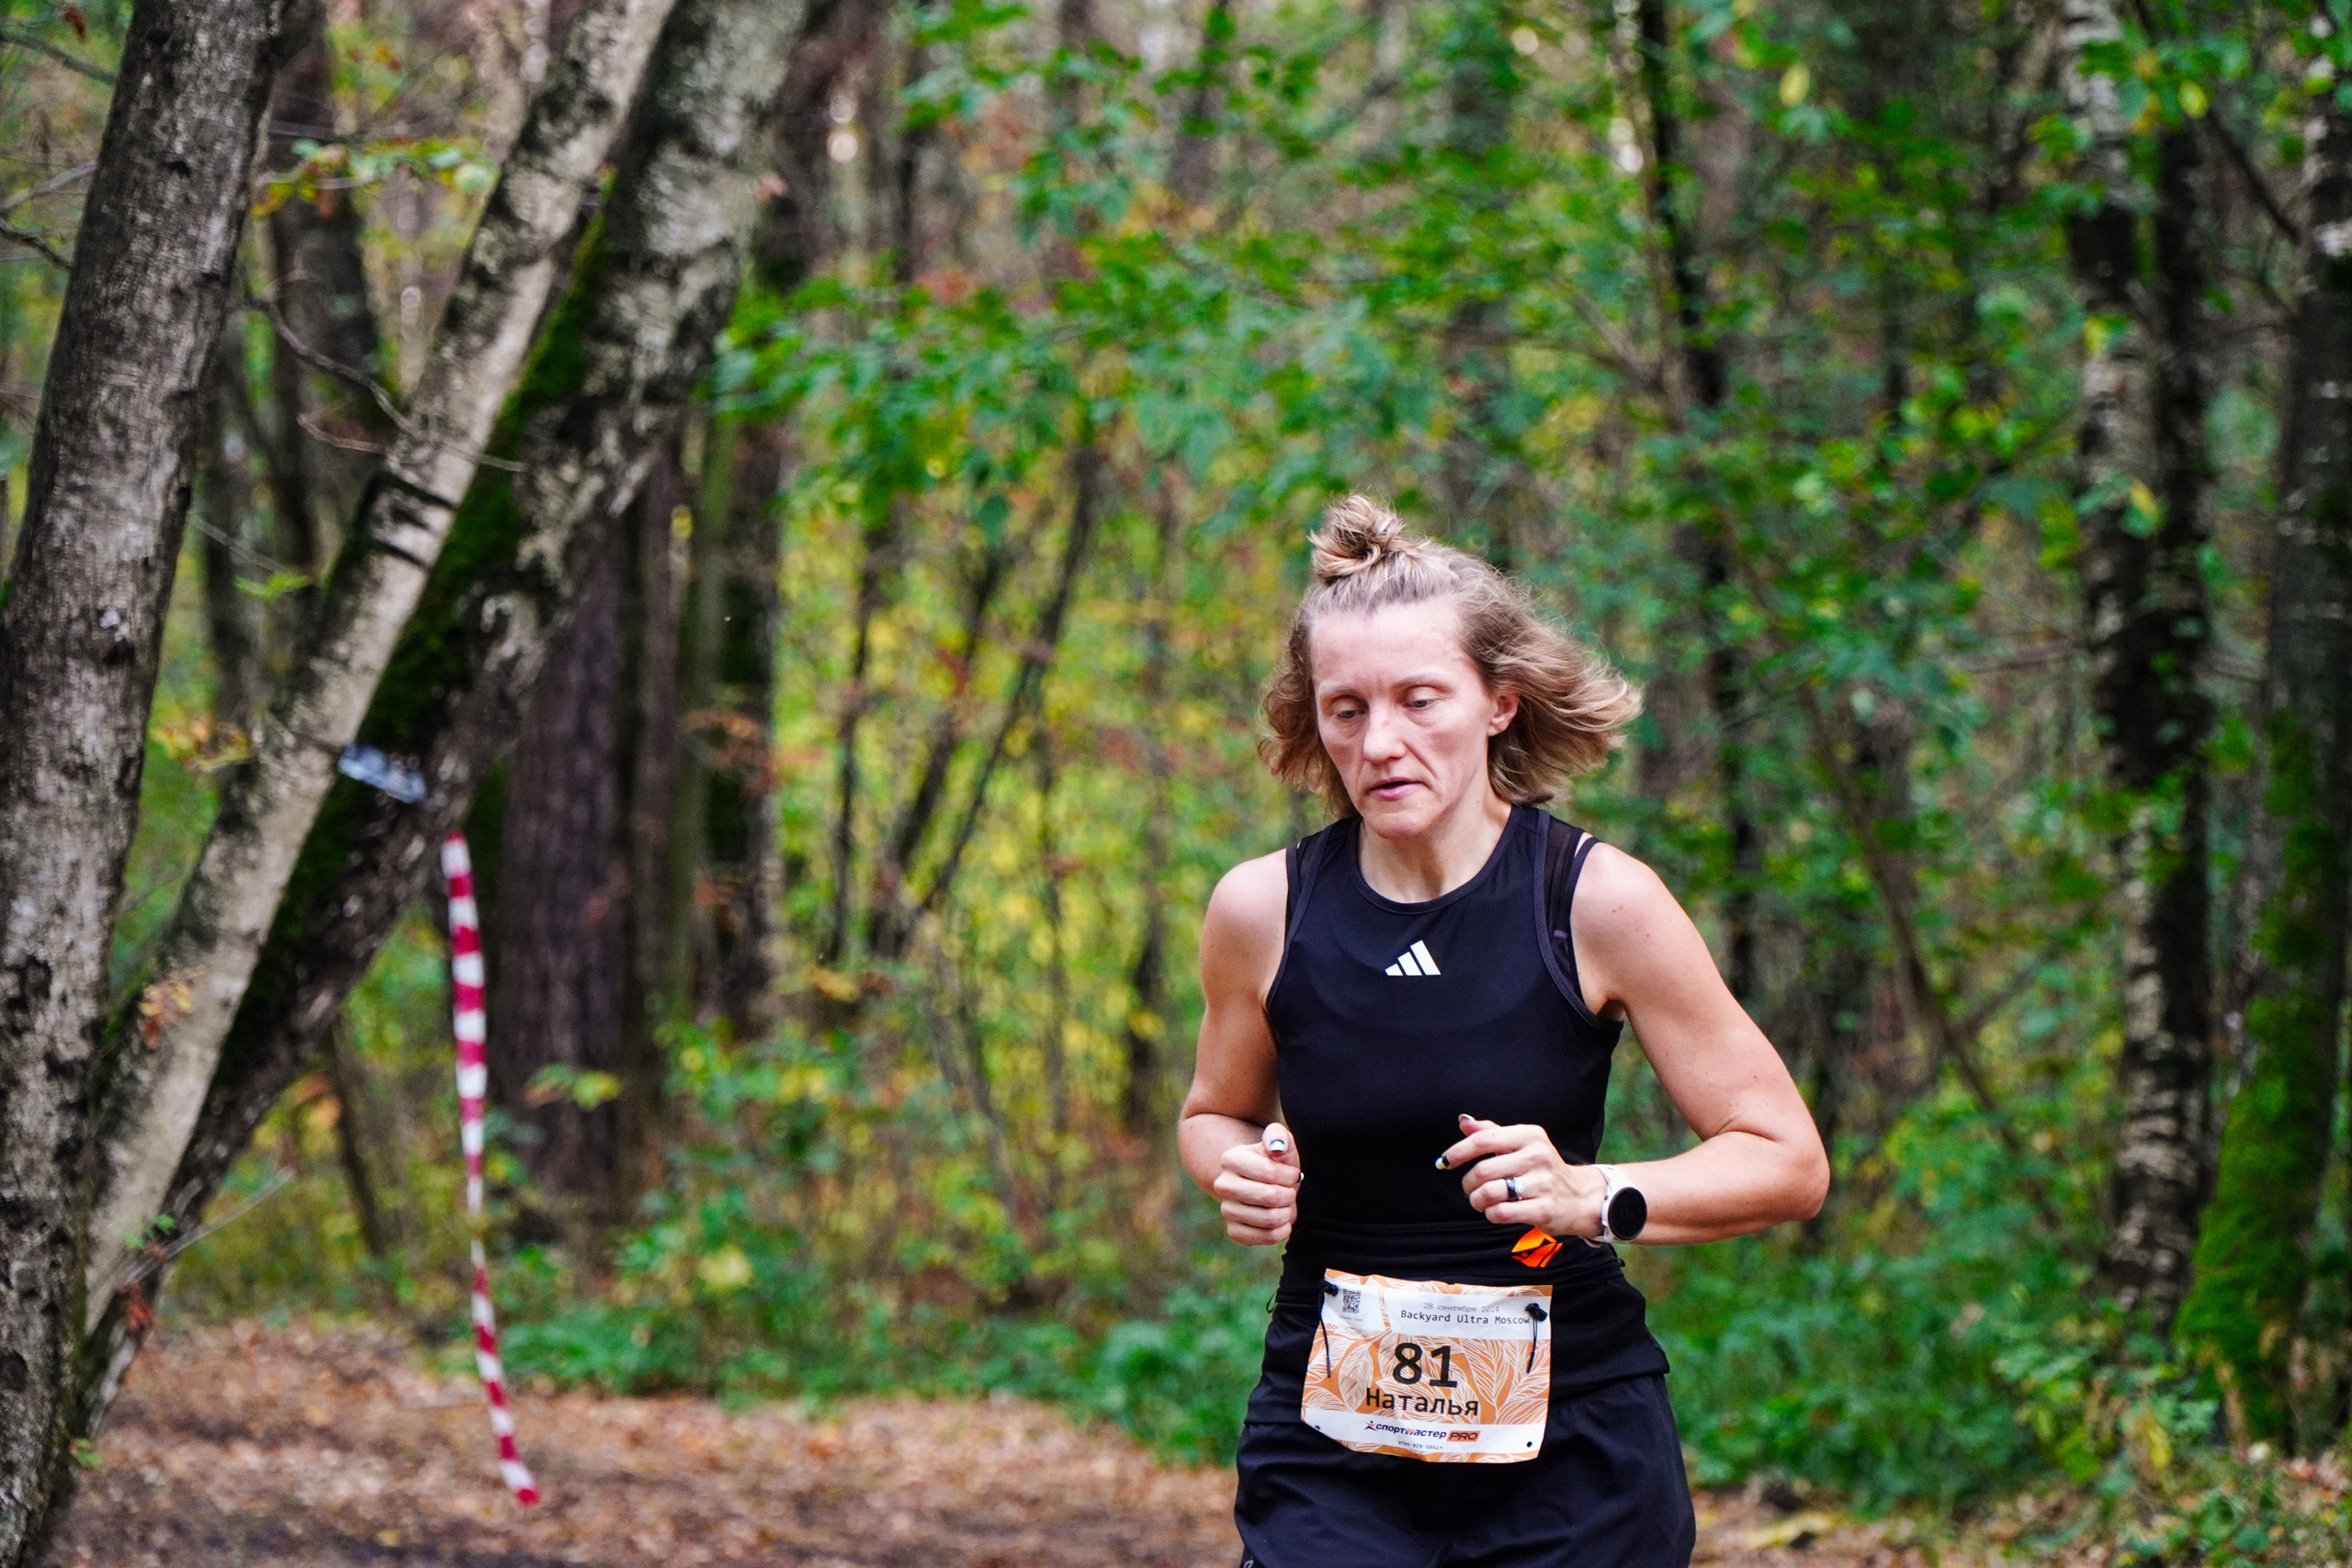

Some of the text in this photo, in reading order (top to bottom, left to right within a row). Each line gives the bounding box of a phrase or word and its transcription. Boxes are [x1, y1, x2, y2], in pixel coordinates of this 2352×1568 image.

[1423, 1302, 1433, 1310] 28
[1437, 1304, 1476, 1313] сентября
[1401, 1310, 1451, 1323] Backyard
[1457, 1314, 1488, 1325] Ultra
[1393, 1342, 1458, 1388] 81
[1366, 1387, 1479, 1416] Наталья
[1449, 1432, 1478, 1441] PRO
